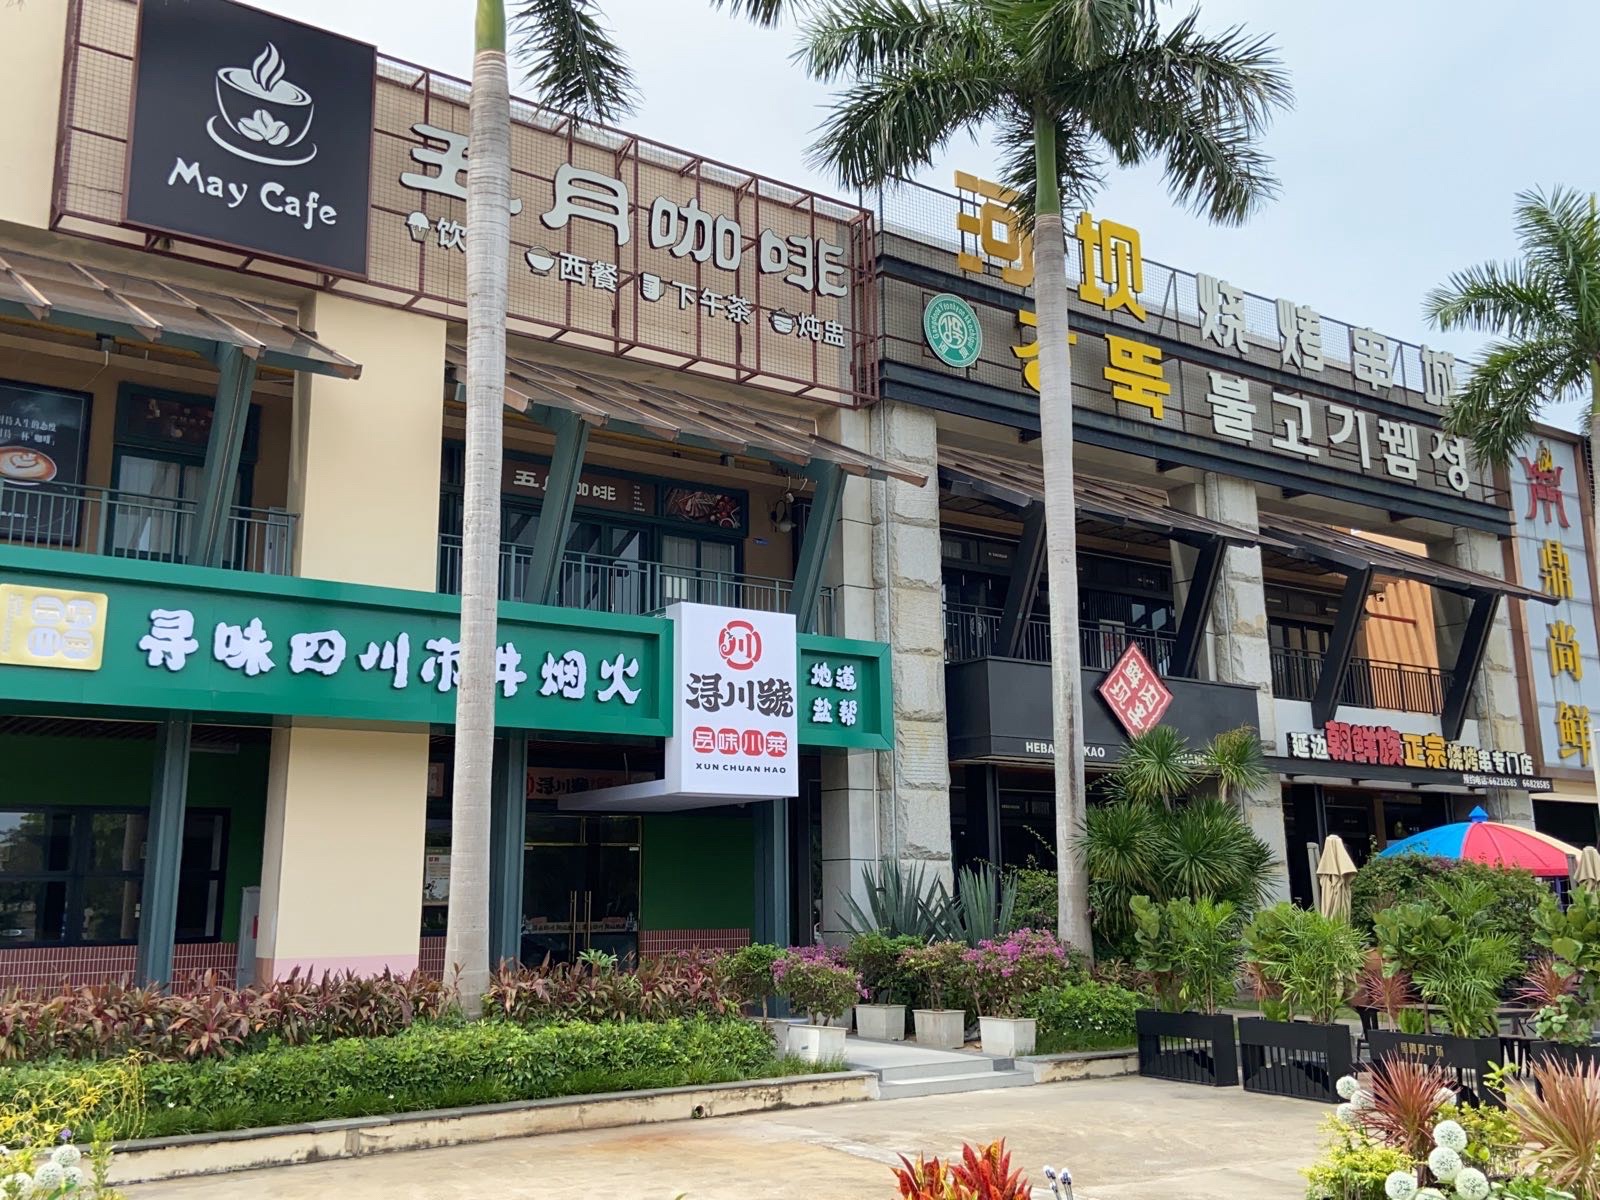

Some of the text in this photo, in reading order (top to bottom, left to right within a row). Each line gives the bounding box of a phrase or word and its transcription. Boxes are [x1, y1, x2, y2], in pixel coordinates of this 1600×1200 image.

[167, 157, 337, 230] May Cafe
[558, 252, 618, 292] 西餐
[671, 280, 750, 324] 下午茶
[799, 313, 846, 348] 炖盅
[1196, 272, 1456, 406] 烧烤串城
[513, 470, 617, 501] 五啡
[138, 609, 642, 704] 寻味四川市井烟火
[1538, 539, 1591, 768] 鼎尚鲜
[686, 672, 794, 718] 浔川號
[811, 662, 857, 691] 地道
[812, 697, 858, 726] 盐帮
[693, 726, 787, 758] 品味川菜
[696, 762, 786, 774] XUN CHUAN HAO
